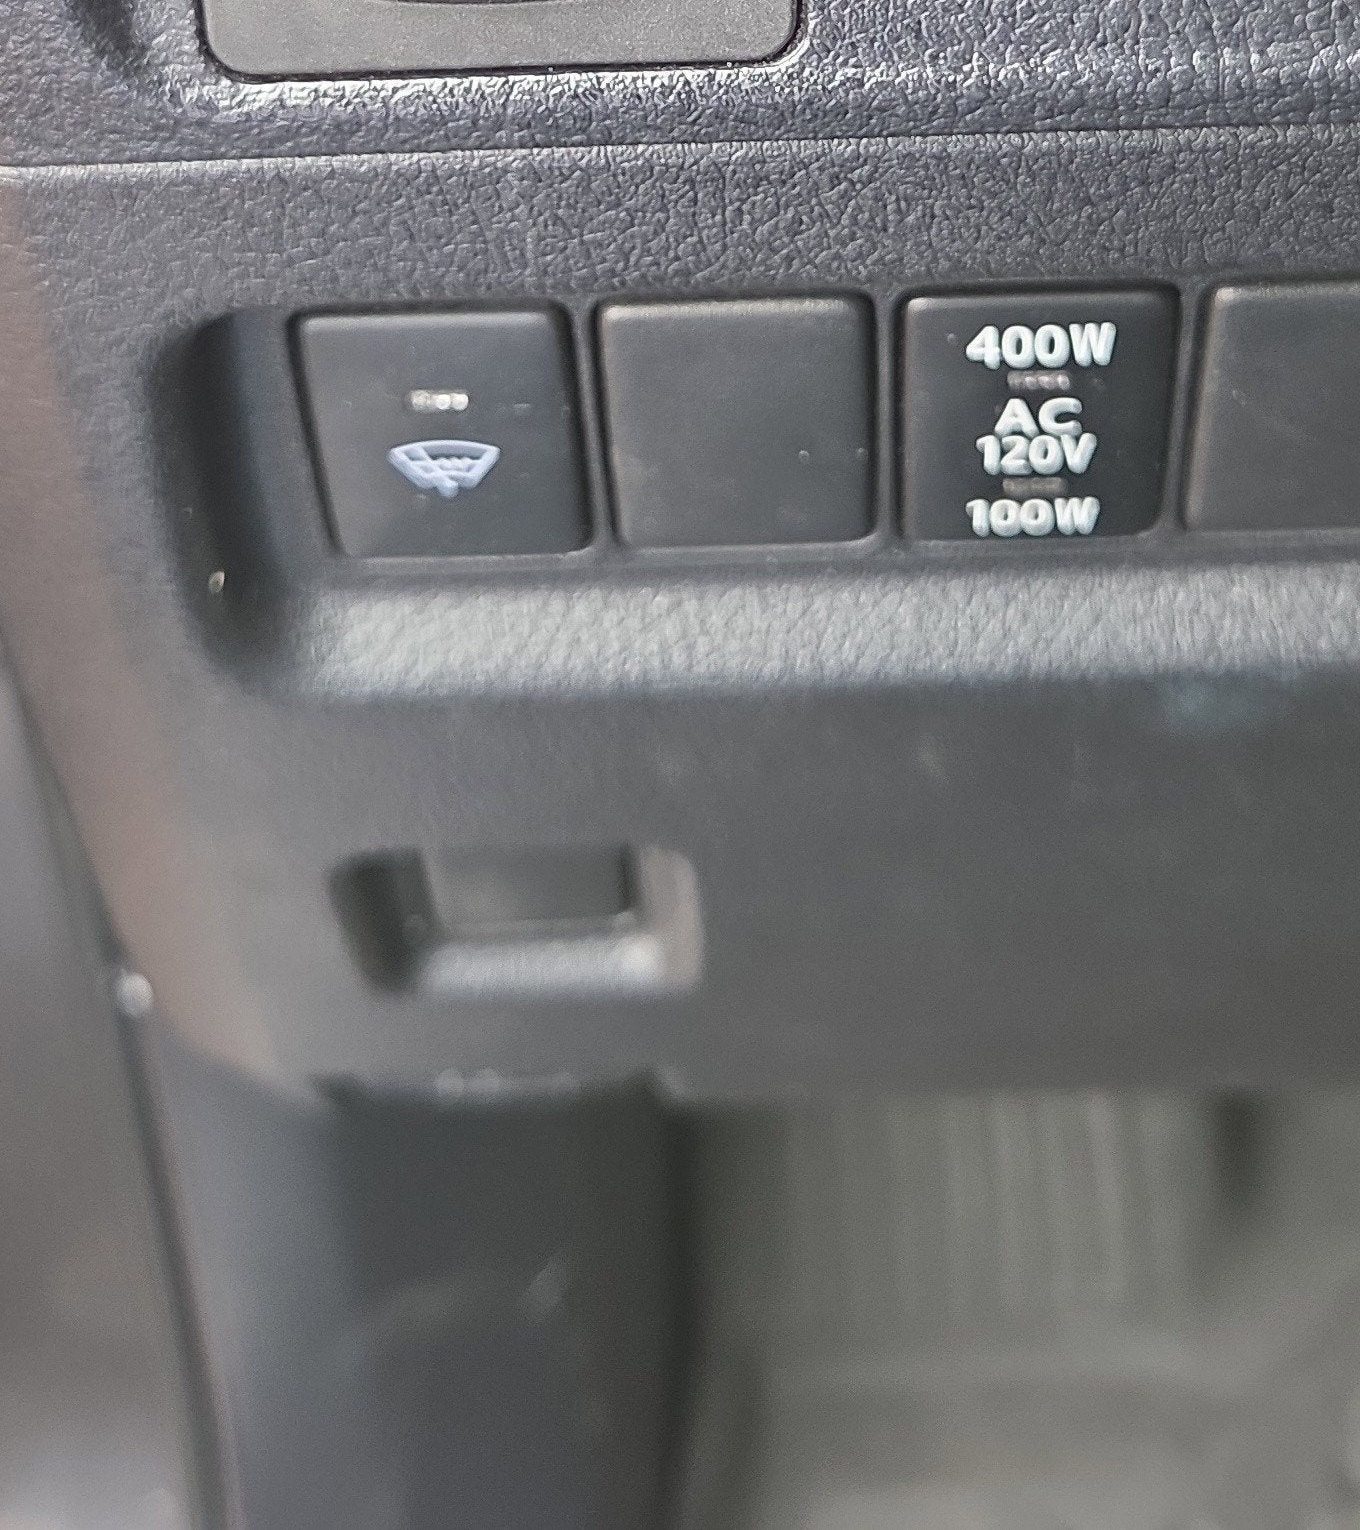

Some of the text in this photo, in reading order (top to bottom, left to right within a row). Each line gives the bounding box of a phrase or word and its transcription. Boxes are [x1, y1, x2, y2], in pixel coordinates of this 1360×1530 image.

[965, 321, 1117, 370] 400W
[994, 396, 1083, 438] AC
[975, 432, 1098, 476] 120V
[965, 496, 1101, 538] 100W
